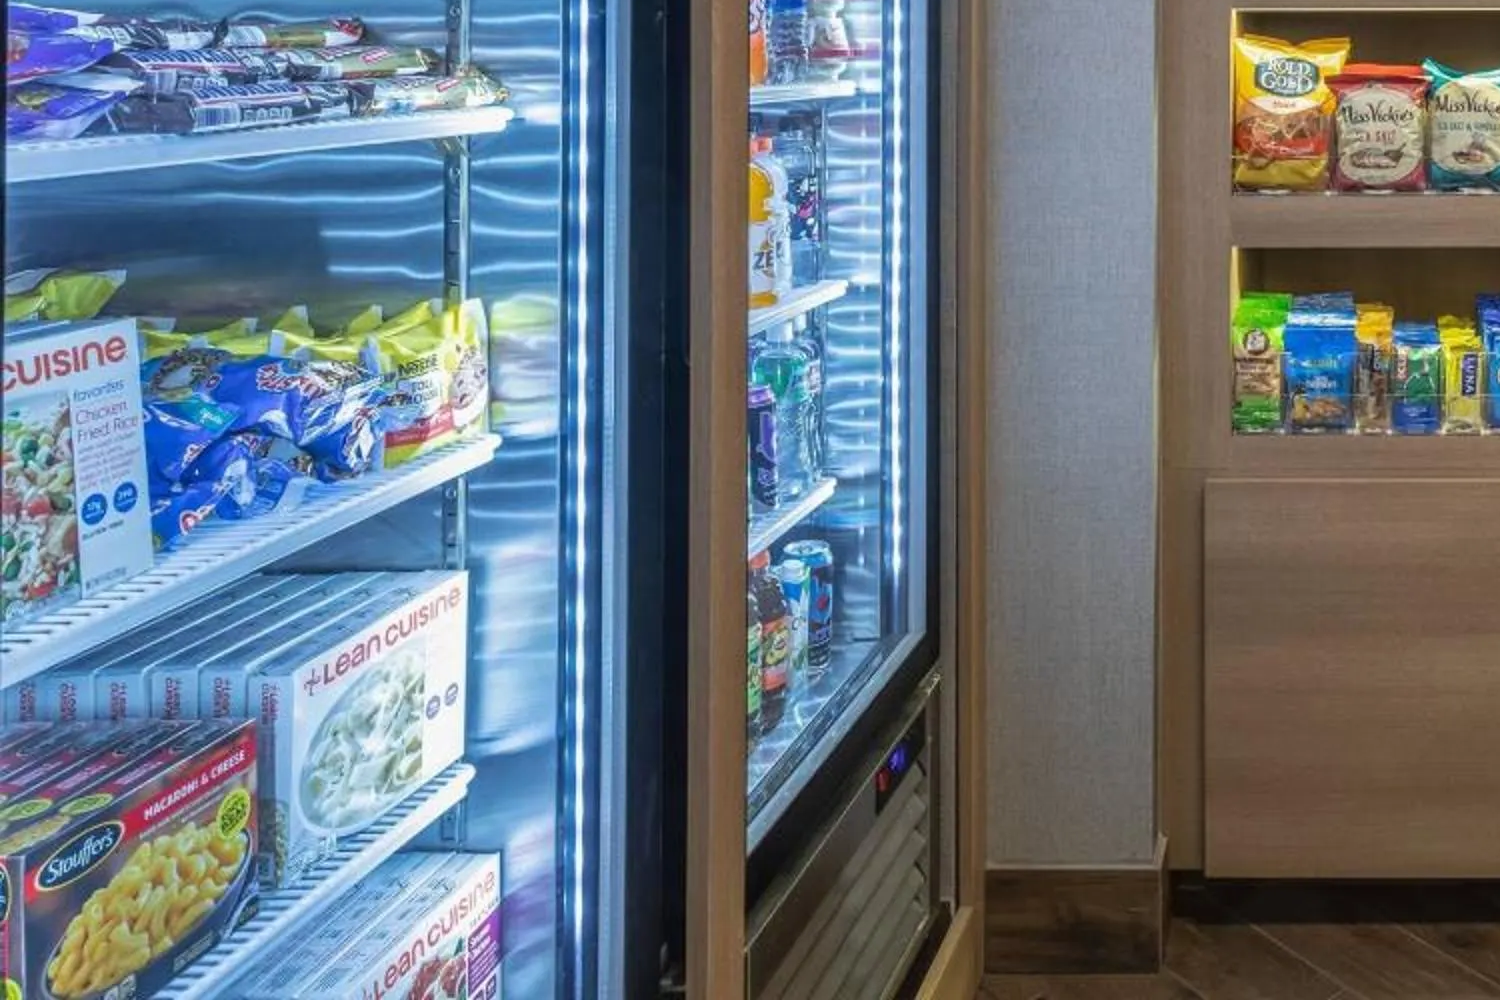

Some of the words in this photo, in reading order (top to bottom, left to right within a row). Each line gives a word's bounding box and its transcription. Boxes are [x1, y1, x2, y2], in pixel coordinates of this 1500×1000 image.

[1463, 356, 1476, 395] LUNA
[75, 400, 128, 425] Chicken
[77, 422, 110, 444] Fried
[113, 415, 138, 432] Rice
[143, 781, 200, 821] MACARONI
[201, 774, 210, 787] &
[211, 750, 246, 780] CHEESE
